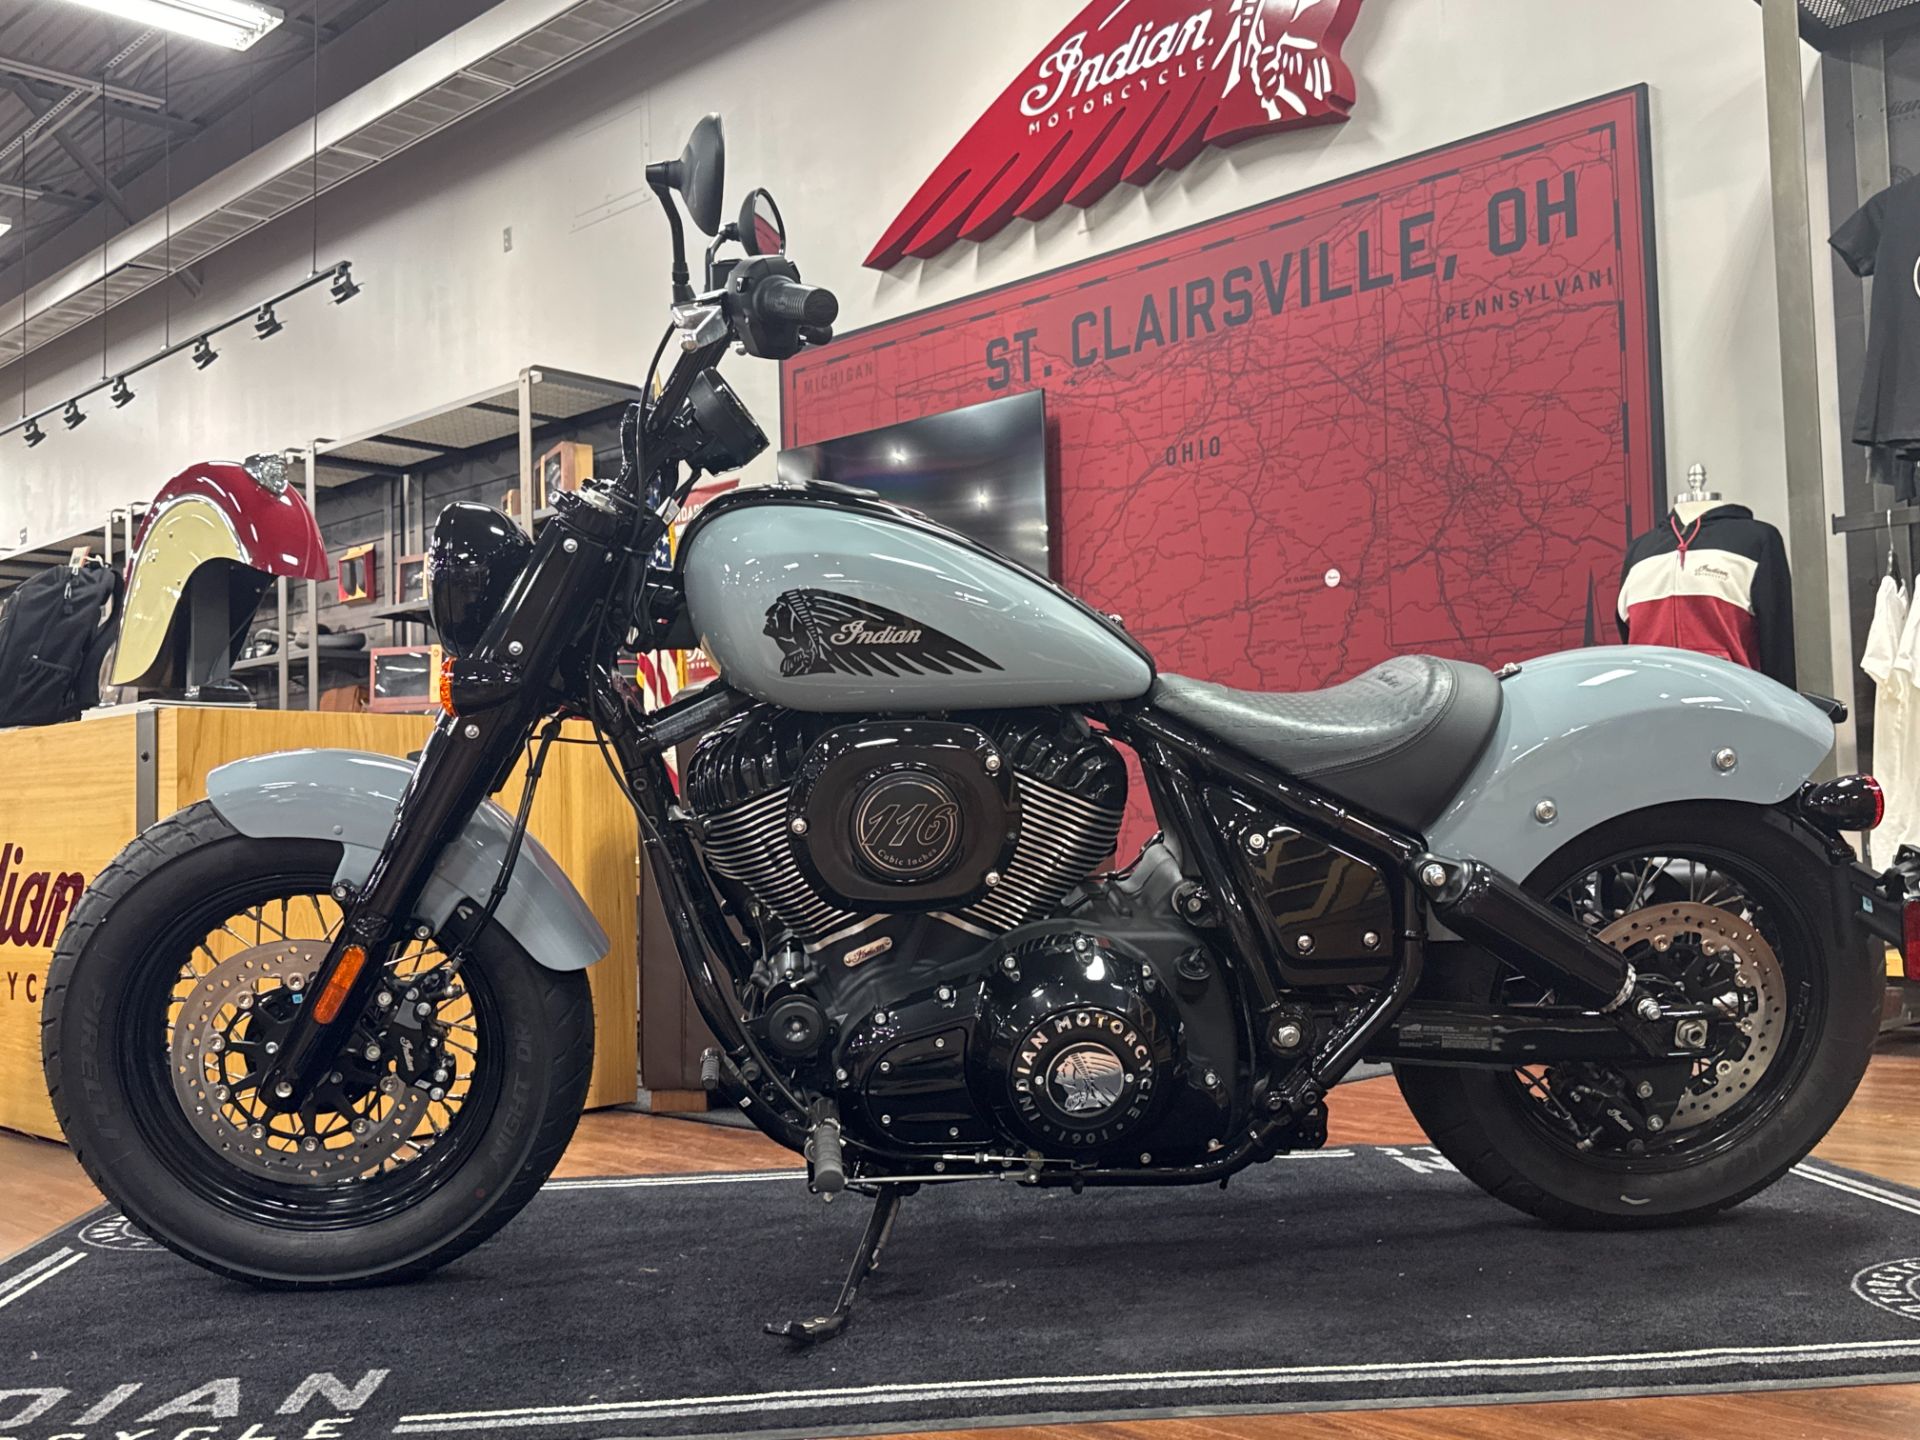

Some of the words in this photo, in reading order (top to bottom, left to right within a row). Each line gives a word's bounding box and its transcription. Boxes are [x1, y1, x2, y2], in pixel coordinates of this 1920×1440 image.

[1028, 55, 1206, 136] MOTORCYCLE
[985, 329, 1053, 391] ST.
[1070, 211, 1458, 368] CLAIRSVILLE,
[1486, 170, 1579, 257] OH
[1444, 266, 1614, 324] PENNSYLVANI
[803, 361, 873, 394] MICHIGAN
[1165, 436, 1221, 467] OHIO
[830, 619, 922, 646] Indian
[861, 801, 959, 847] 116
[877, 848, 904, 866] Cubic
[907, 848, 938, 866] Inches
[1015, 1031, 1049, 1121] INDIAN
[1054, 1012, 1153, 1120] MOTORCYCLE
[1058, 1129, 1109, 1145] 1901
